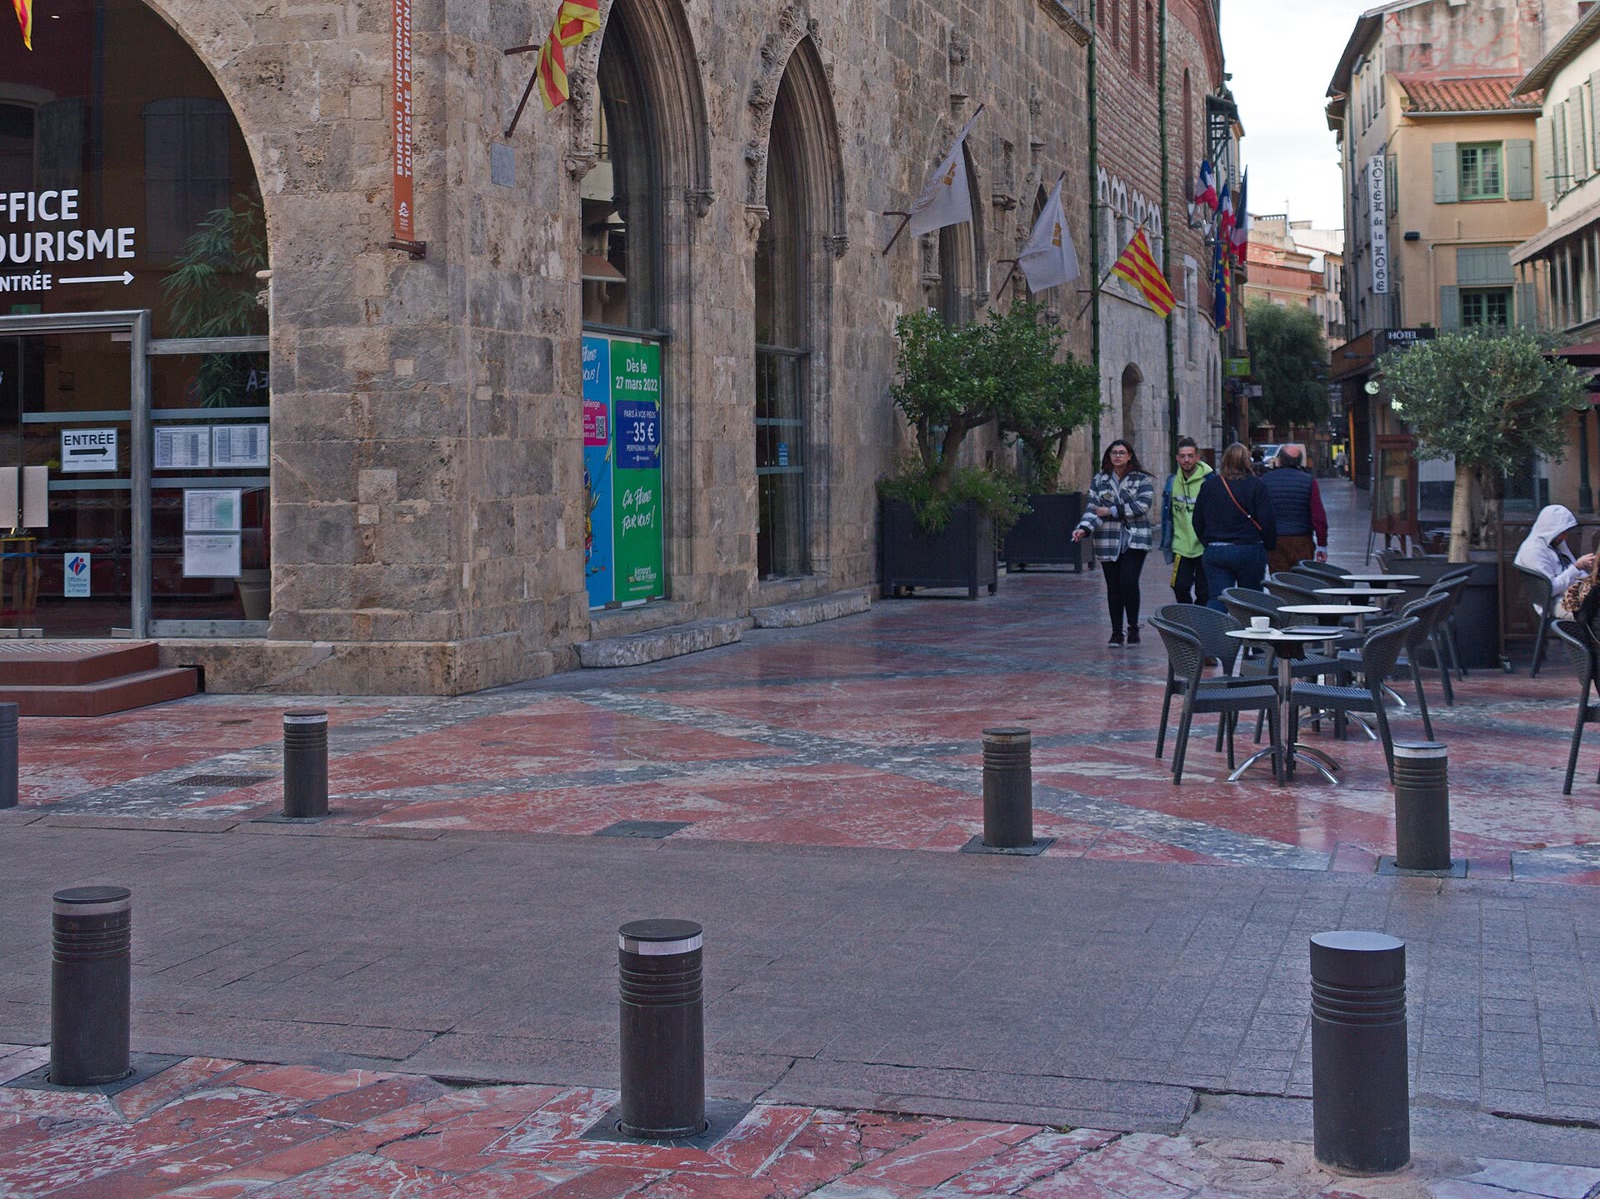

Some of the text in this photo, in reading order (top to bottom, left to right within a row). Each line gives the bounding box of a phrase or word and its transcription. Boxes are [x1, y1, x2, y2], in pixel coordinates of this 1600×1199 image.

[396, 110, 404, 176] BUREAU
[404, 89, 412, 178] TOURISME
[626, 357, 648, 374] Dès le
[616, 376, 658, 392] 27 mars 2022
[64, 431, 115, 446] ENTRÉE
[633, 421, 655, 443] 35 €
